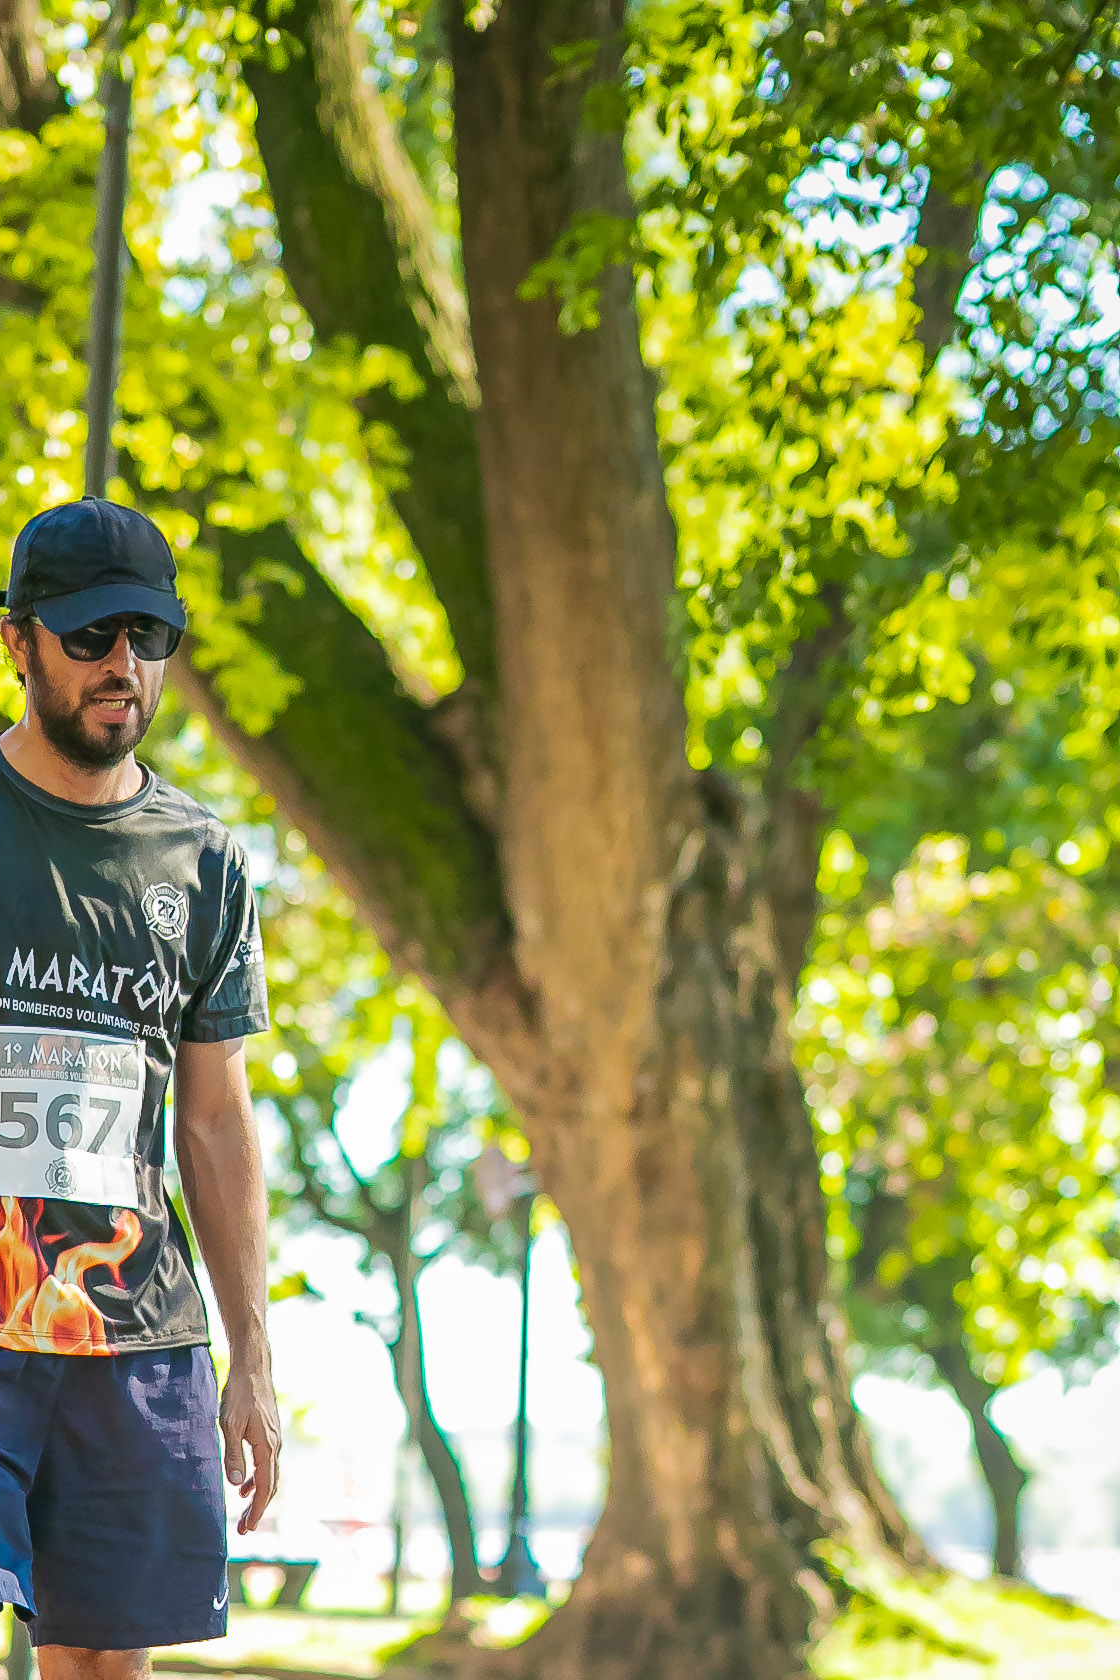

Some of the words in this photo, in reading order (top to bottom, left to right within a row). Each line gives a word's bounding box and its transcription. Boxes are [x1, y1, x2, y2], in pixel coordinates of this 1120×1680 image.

[157, 899, 177, 919] 27
[6, 946, 179, 1015] MARATÓN
[12, 998, 73, 1020] BOMBEROS
[29, 1043, 123, 1072] MARATÓN
[31, 1069, 69, 1080] BOMBEROS
[70, 1072, 111, 1085] VOLUNTARIOS
[111, 1076, 137, 1089] ROSARIO
